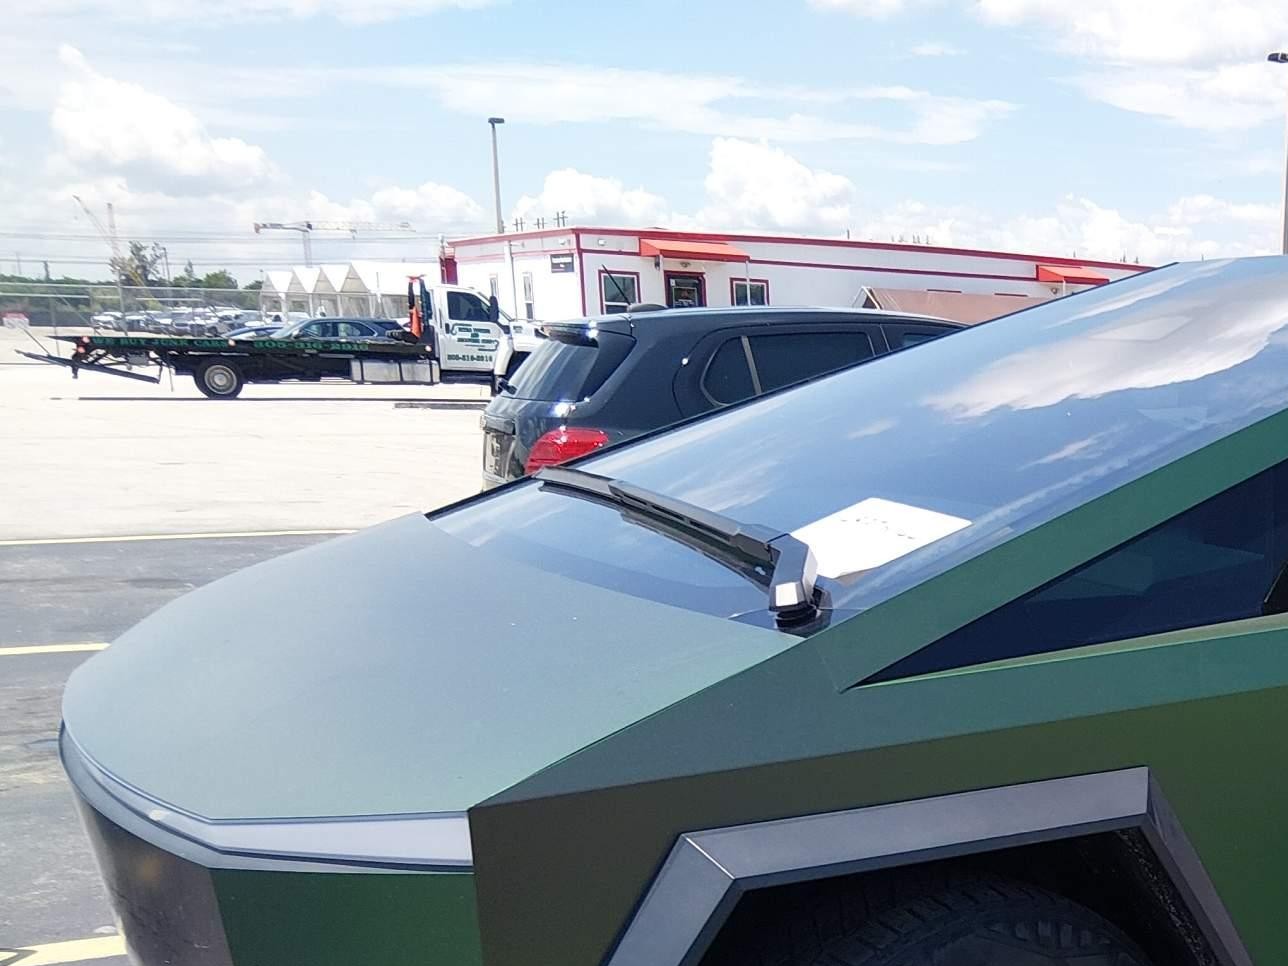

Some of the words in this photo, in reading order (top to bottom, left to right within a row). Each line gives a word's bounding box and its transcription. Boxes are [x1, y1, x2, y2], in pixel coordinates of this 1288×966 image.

[92, 337, 114, 345] WE
[119, 337, 147, 345] BUY
[151, 338, 189, 346] JUNK
[193, 339, 229, 347] CARS
